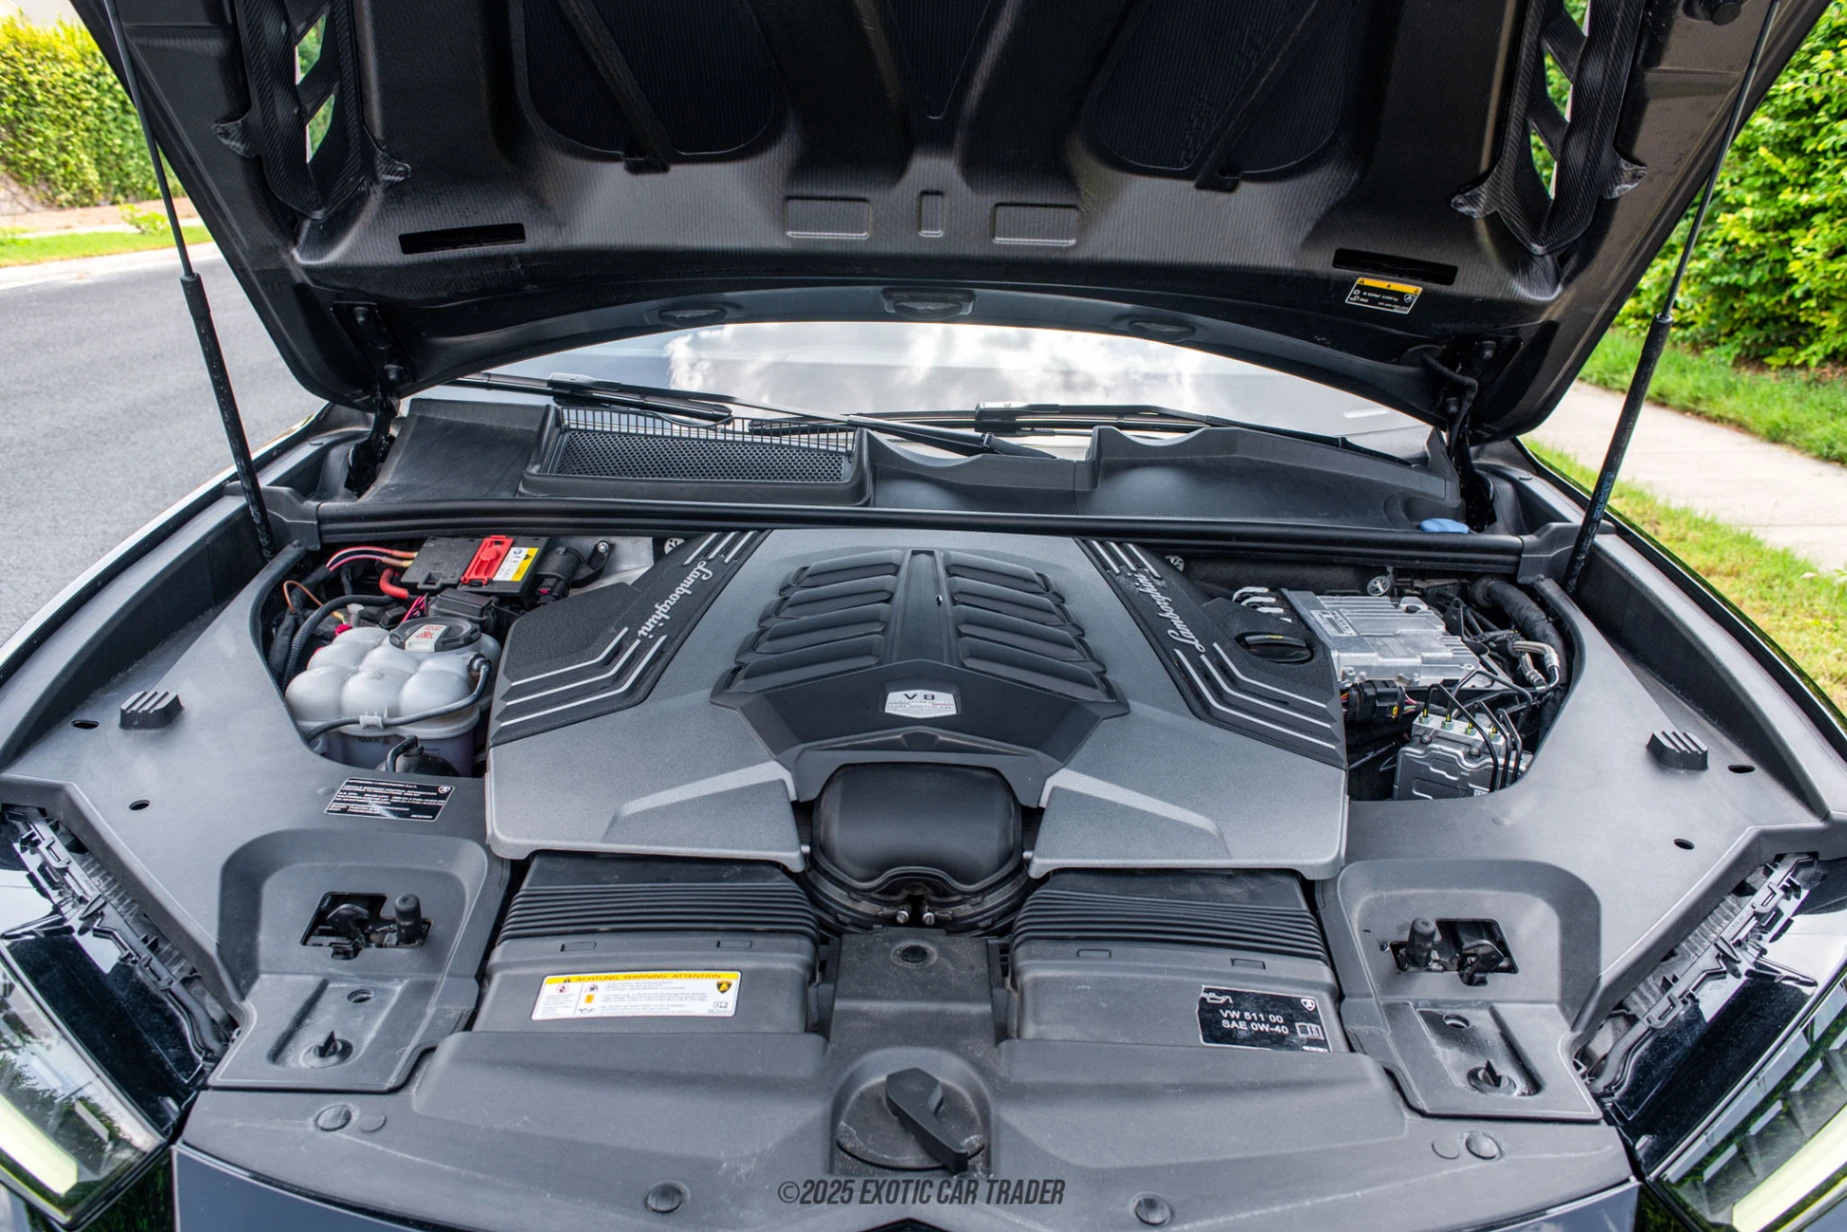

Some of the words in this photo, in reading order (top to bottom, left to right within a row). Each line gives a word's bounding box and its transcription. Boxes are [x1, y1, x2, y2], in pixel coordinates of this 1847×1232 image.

[637, 560, 713, 639] Lamborghini
[1127, 571, 1206, 653] Lamborghini
[1219, 1008, 1240, 1020] VW
[1243, 1011, 1265, 1022] 511
[1268, 1014, 1284, 1023] 00
[1221, 1019, 1248, 1030] SAE
[1250, 1022, 1289, 1035] 0W-40
